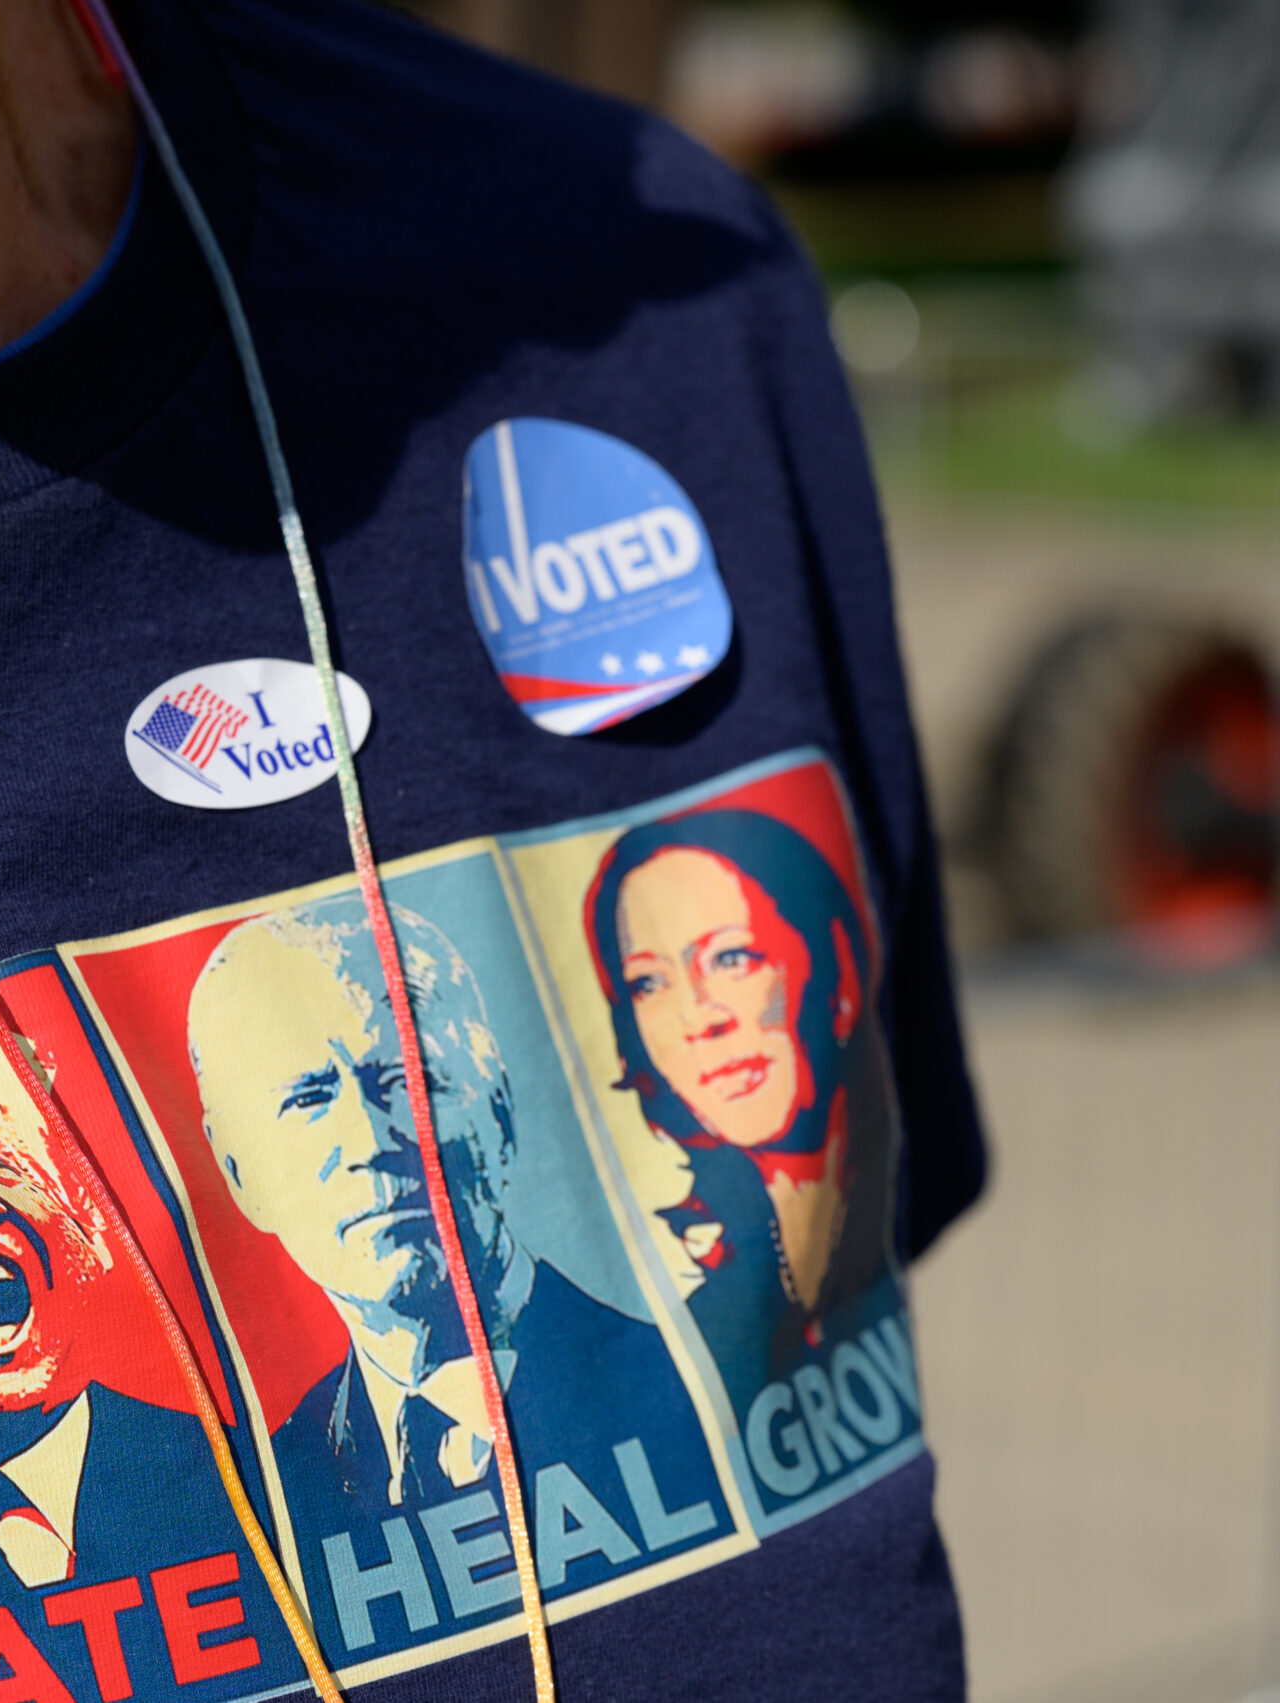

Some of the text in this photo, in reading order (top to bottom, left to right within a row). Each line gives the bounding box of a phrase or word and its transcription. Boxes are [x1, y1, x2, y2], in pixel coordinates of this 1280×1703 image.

[472, 562, 502, 633] I
[489, 420, 702, 625] VOTED
[220, 723, 336, 780] Voted
[246, 690, 276, 730] I
[321, 1436, 718, 1652] HEAL
